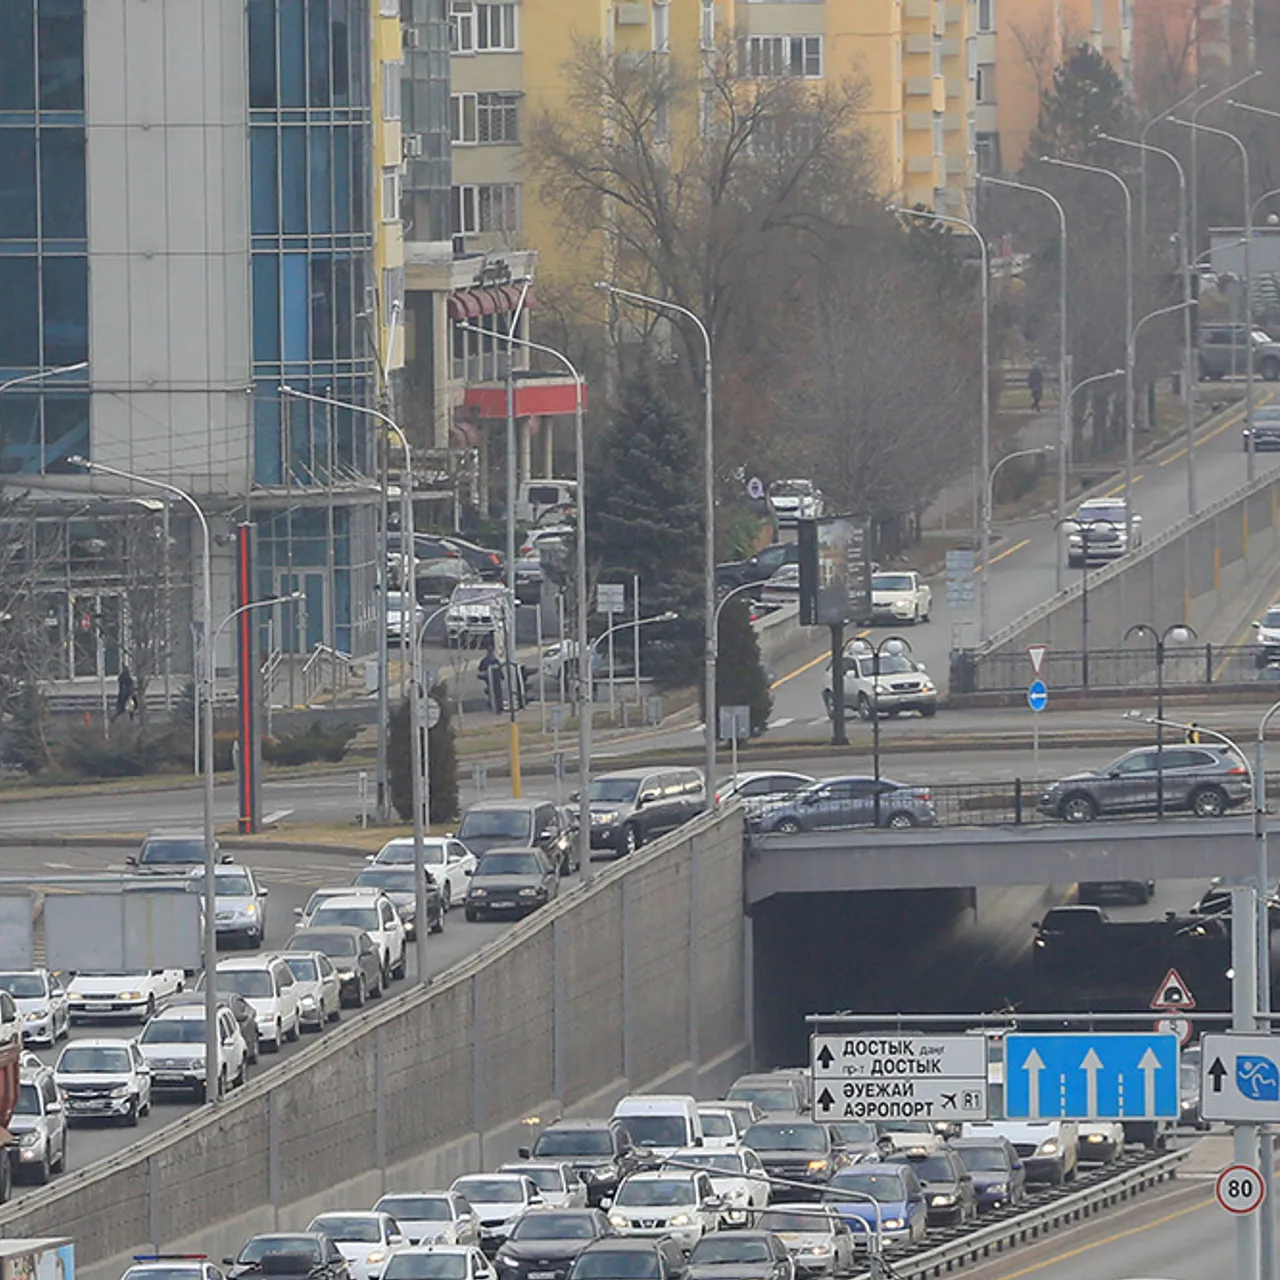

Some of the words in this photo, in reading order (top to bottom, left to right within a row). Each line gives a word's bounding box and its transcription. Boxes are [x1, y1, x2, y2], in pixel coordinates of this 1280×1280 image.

[871, 1059, 942, 1075] ДОСТЫК
[843, 1080, 914, 1098] ӘУЕЖАЙ
[843, 1102, 934, 1117] АЭРОПОРТ
[1227, 1179, 1253, 1198] 80
